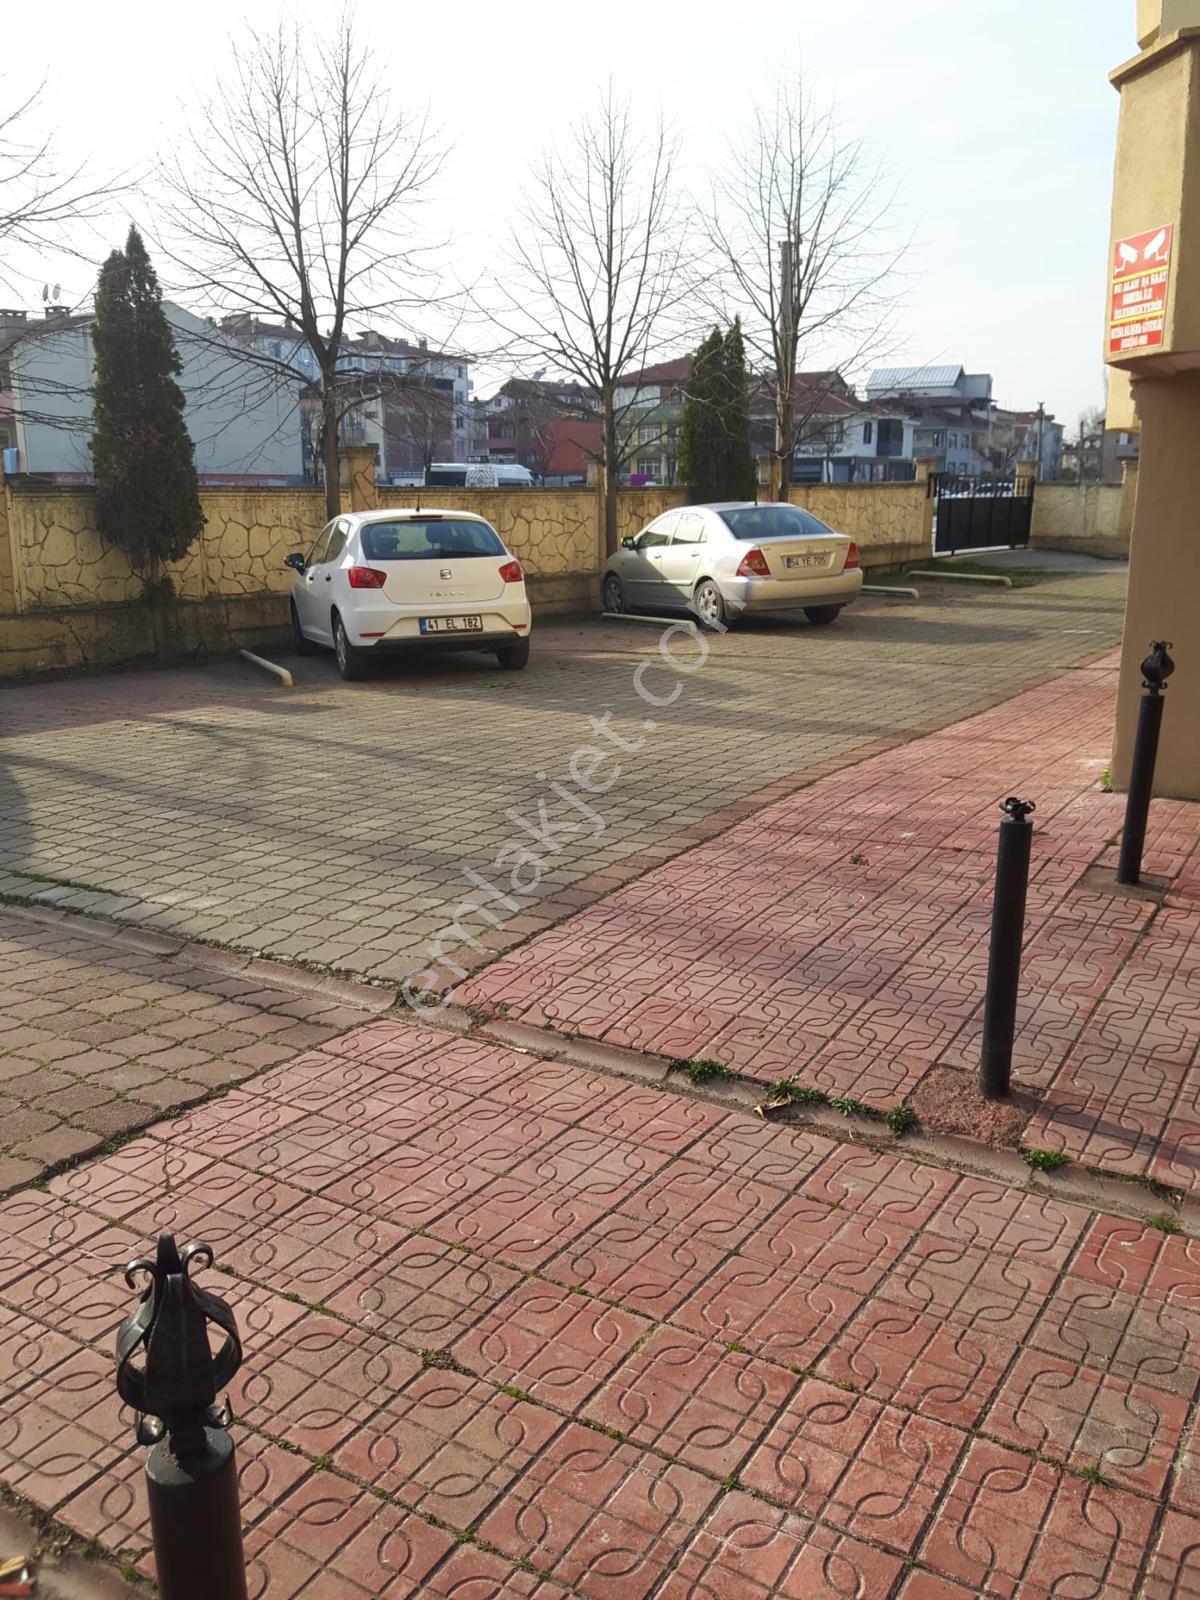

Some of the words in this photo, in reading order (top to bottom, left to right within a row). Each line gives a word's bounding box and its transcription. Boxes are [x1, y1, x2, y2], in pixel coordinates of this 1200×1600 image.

[1123, 279, 1140, 292] ALAN
[1150, 270, 1168, 285] SAAT
[428, 619, 439, 630] 41
[446, 618, 457, 629] EL
[463, 617, 479, 628] 182
